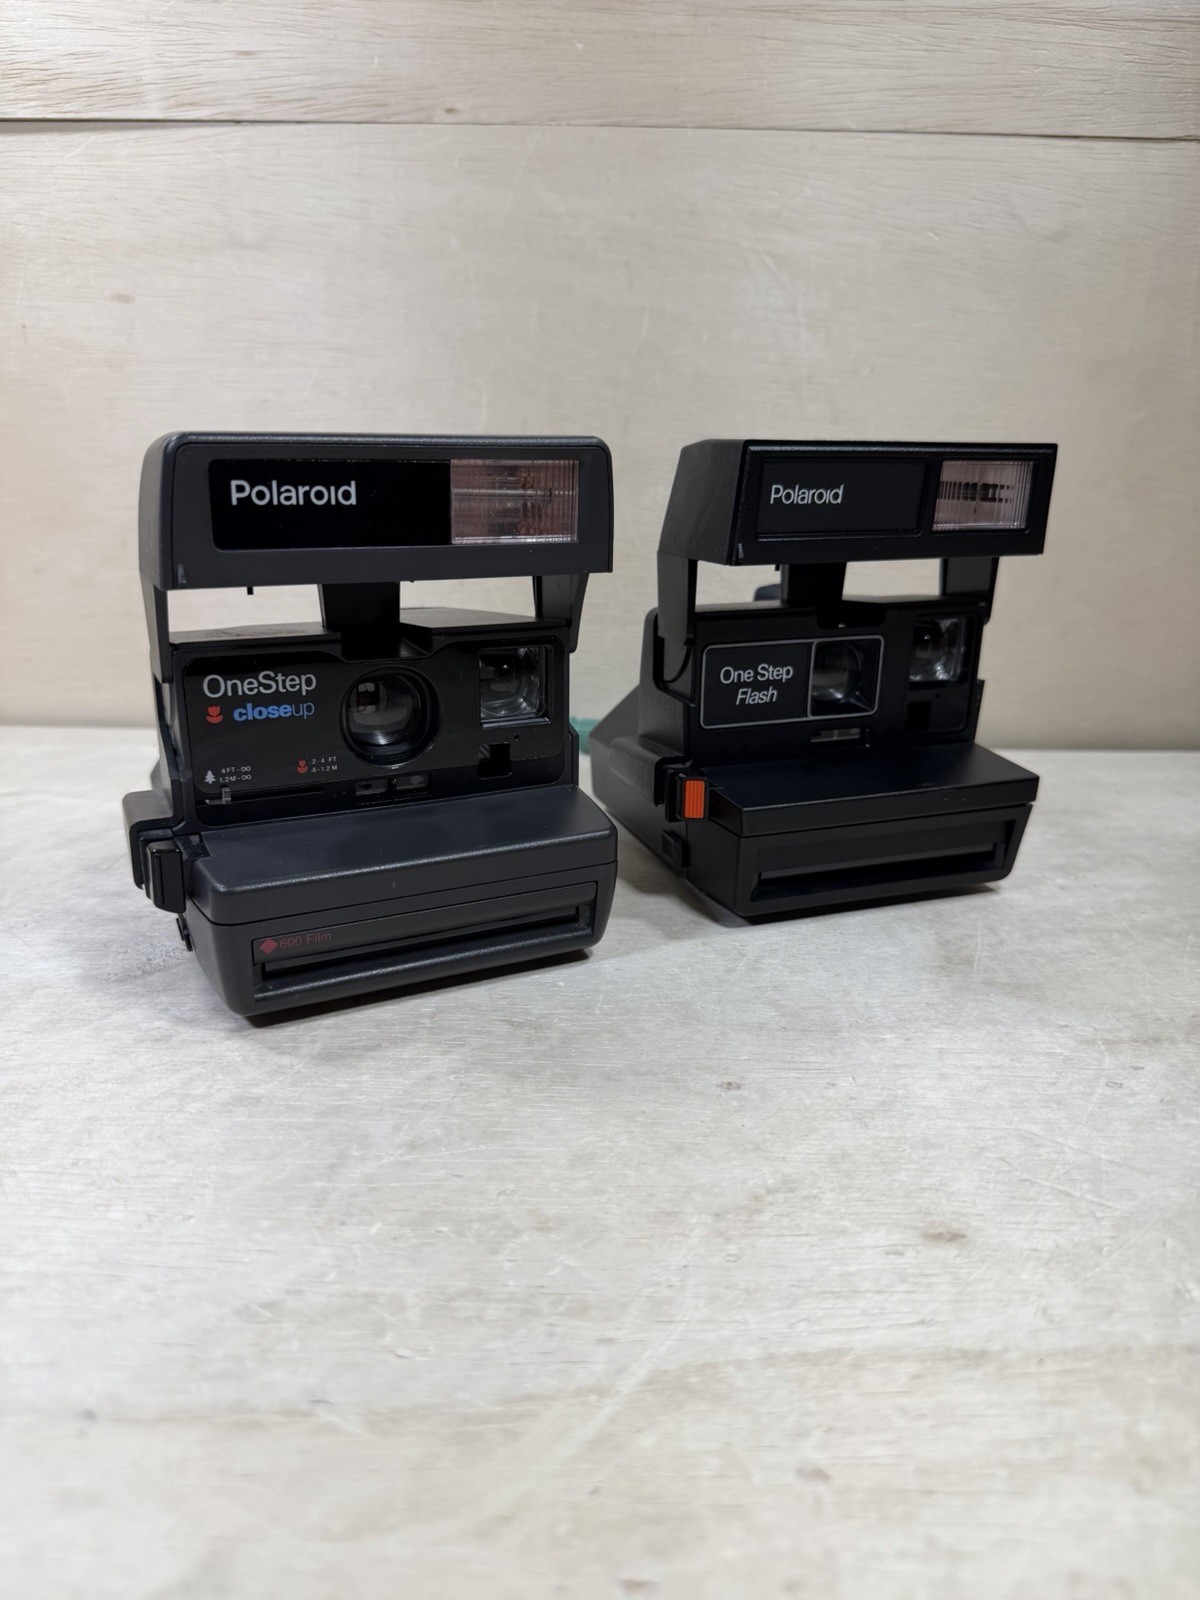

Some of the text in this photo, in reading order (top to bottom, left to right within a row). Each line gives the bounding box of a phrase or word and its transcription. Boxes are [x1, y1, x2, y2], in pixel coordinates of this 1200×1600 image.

[230, 479, 357, 506] Polaroid
[770, 483, 844, 505] Polaroid
[720, 663, 793, 684] One Step
[203, 671, 316, 698] OneStep
[736, 686, 777, 705] Flash
[233, 702, 315, 721] closeup
[279, 932, 332, 949] 600 Film
